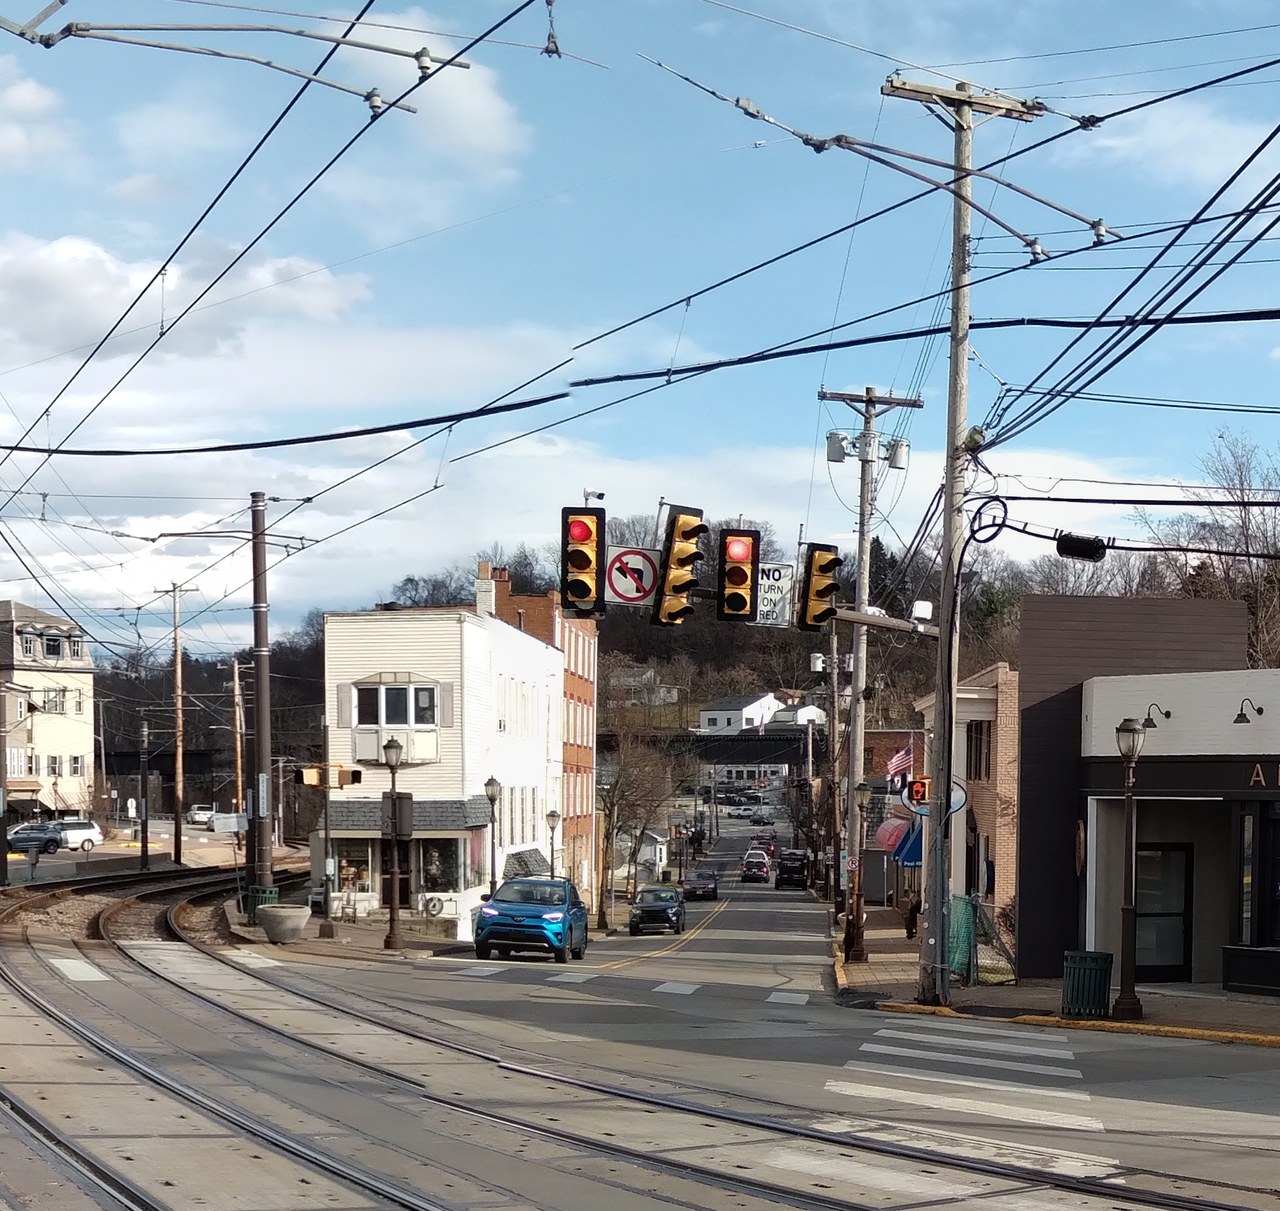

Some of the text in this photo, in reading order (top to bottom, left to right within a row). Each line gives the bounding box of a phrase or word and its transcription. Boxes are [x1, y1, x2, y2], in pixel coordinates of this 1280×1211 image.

[761, 568, 782, 581] NO
[759, 583, 784, 595] TURN
[762, 597, 777, 608] ON
[759, 610, 778, 621] RED
